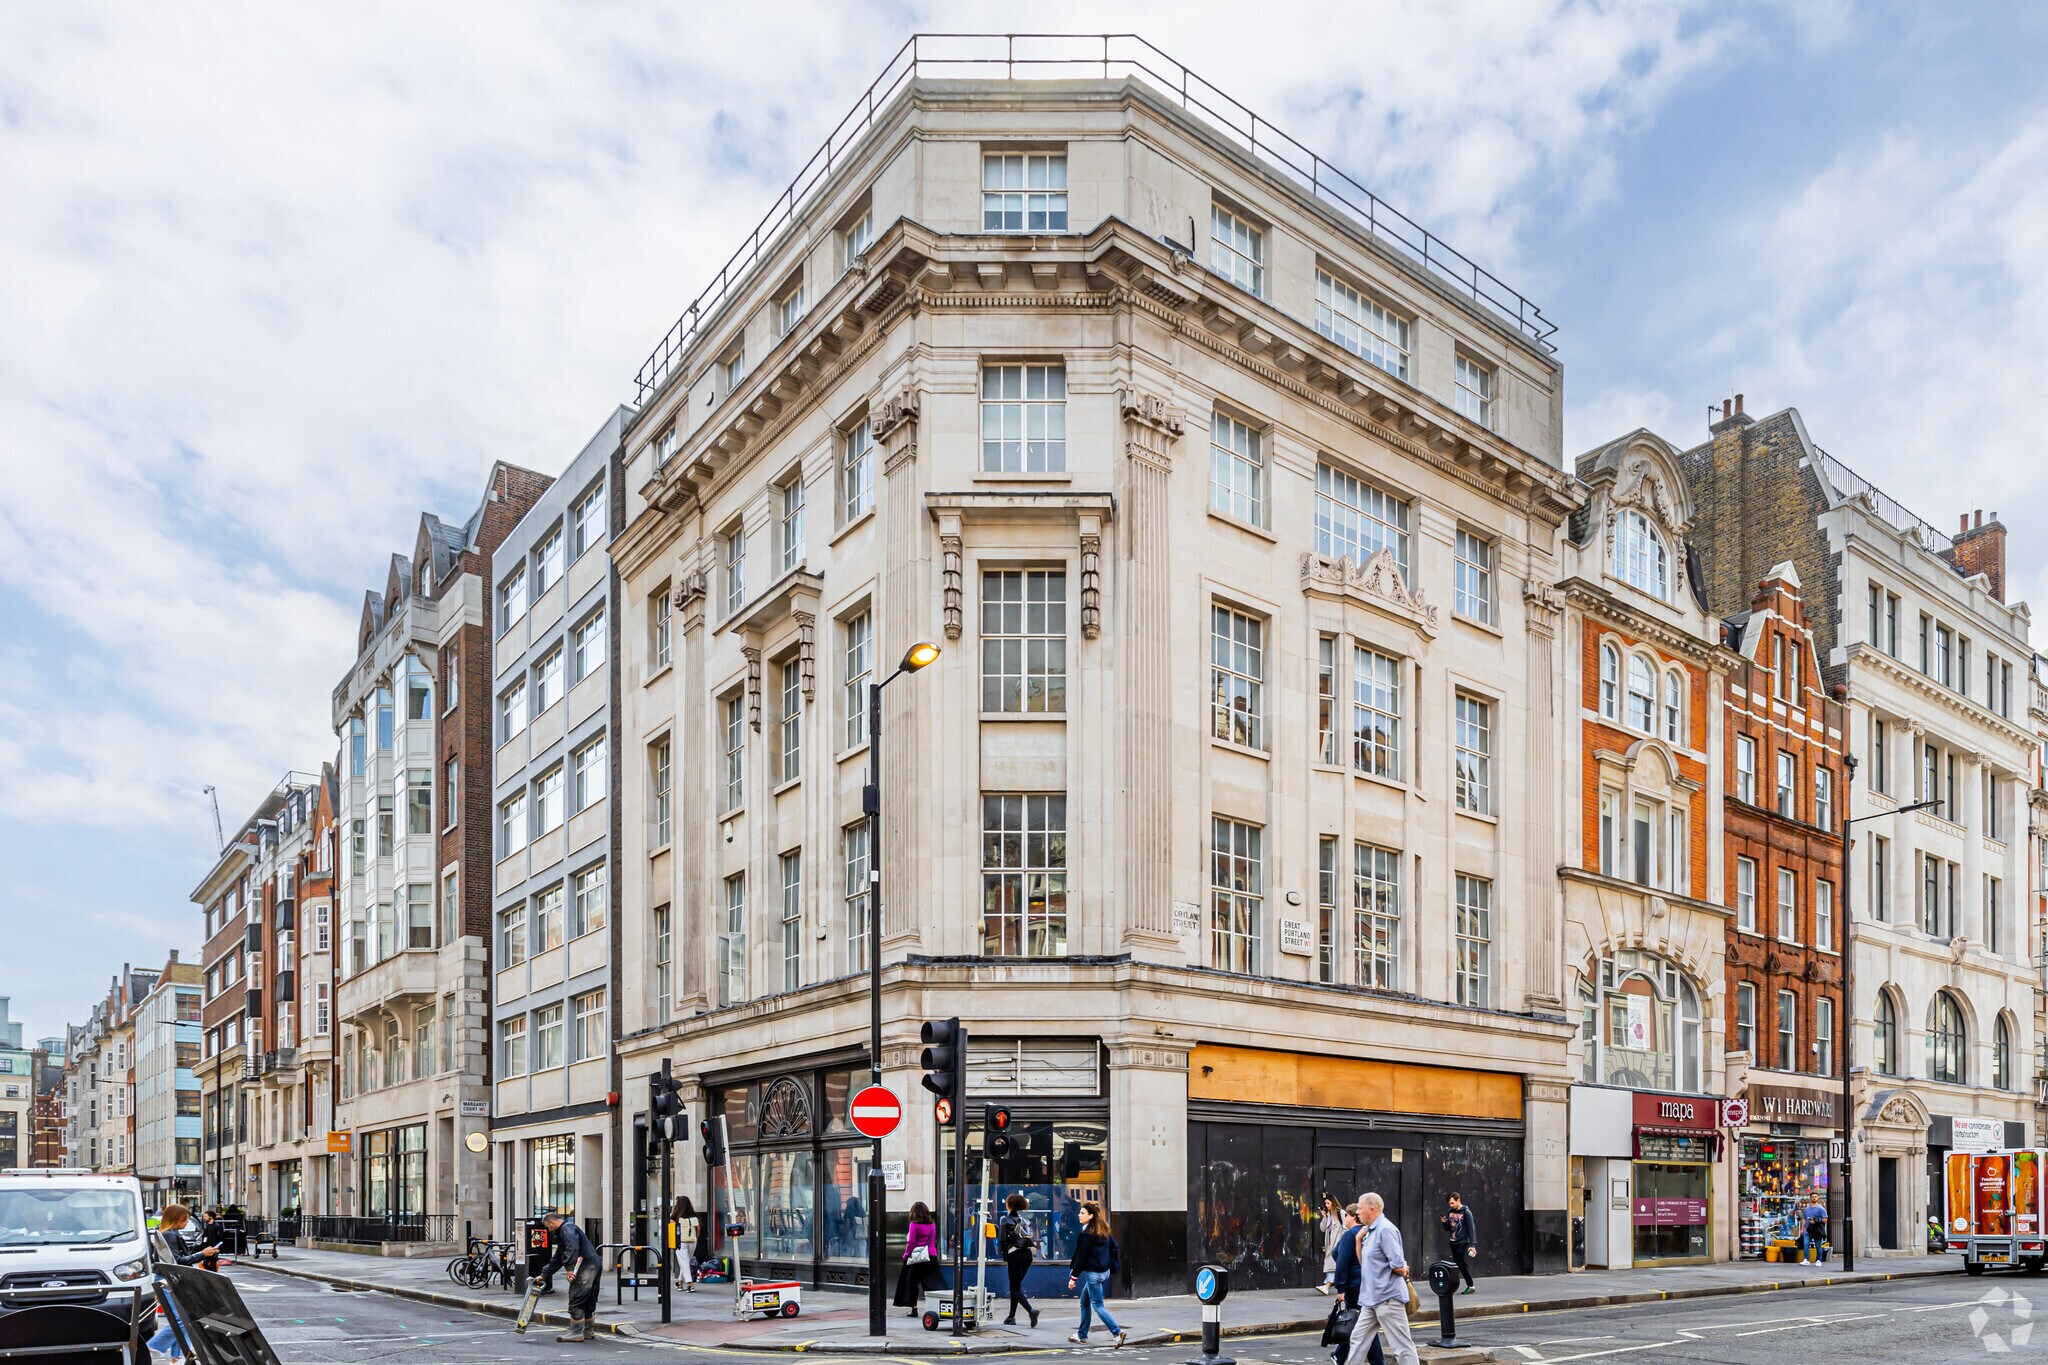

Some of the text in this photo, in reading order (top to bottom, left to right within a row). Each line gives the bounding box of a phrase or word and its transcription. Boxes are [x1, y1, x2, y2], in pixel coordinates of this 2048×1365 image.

[1283, 920, 1301, 930] GREAT
[1284, 928, 1311, 940] PORTLAND
[1284, 936, 1312, 948] STREET W1
[1661, 1101, 1694, 1122] mapa
[1762, 1096, 1833, 1118] W1 HARDWARE
[1727, 1110, 1743, 1118] mapa
[1954, 1119, 1961, 1129] We
[1968, 1122, 1991, 1131] considerate
[1832, 1142, 1845, 1159] DI
